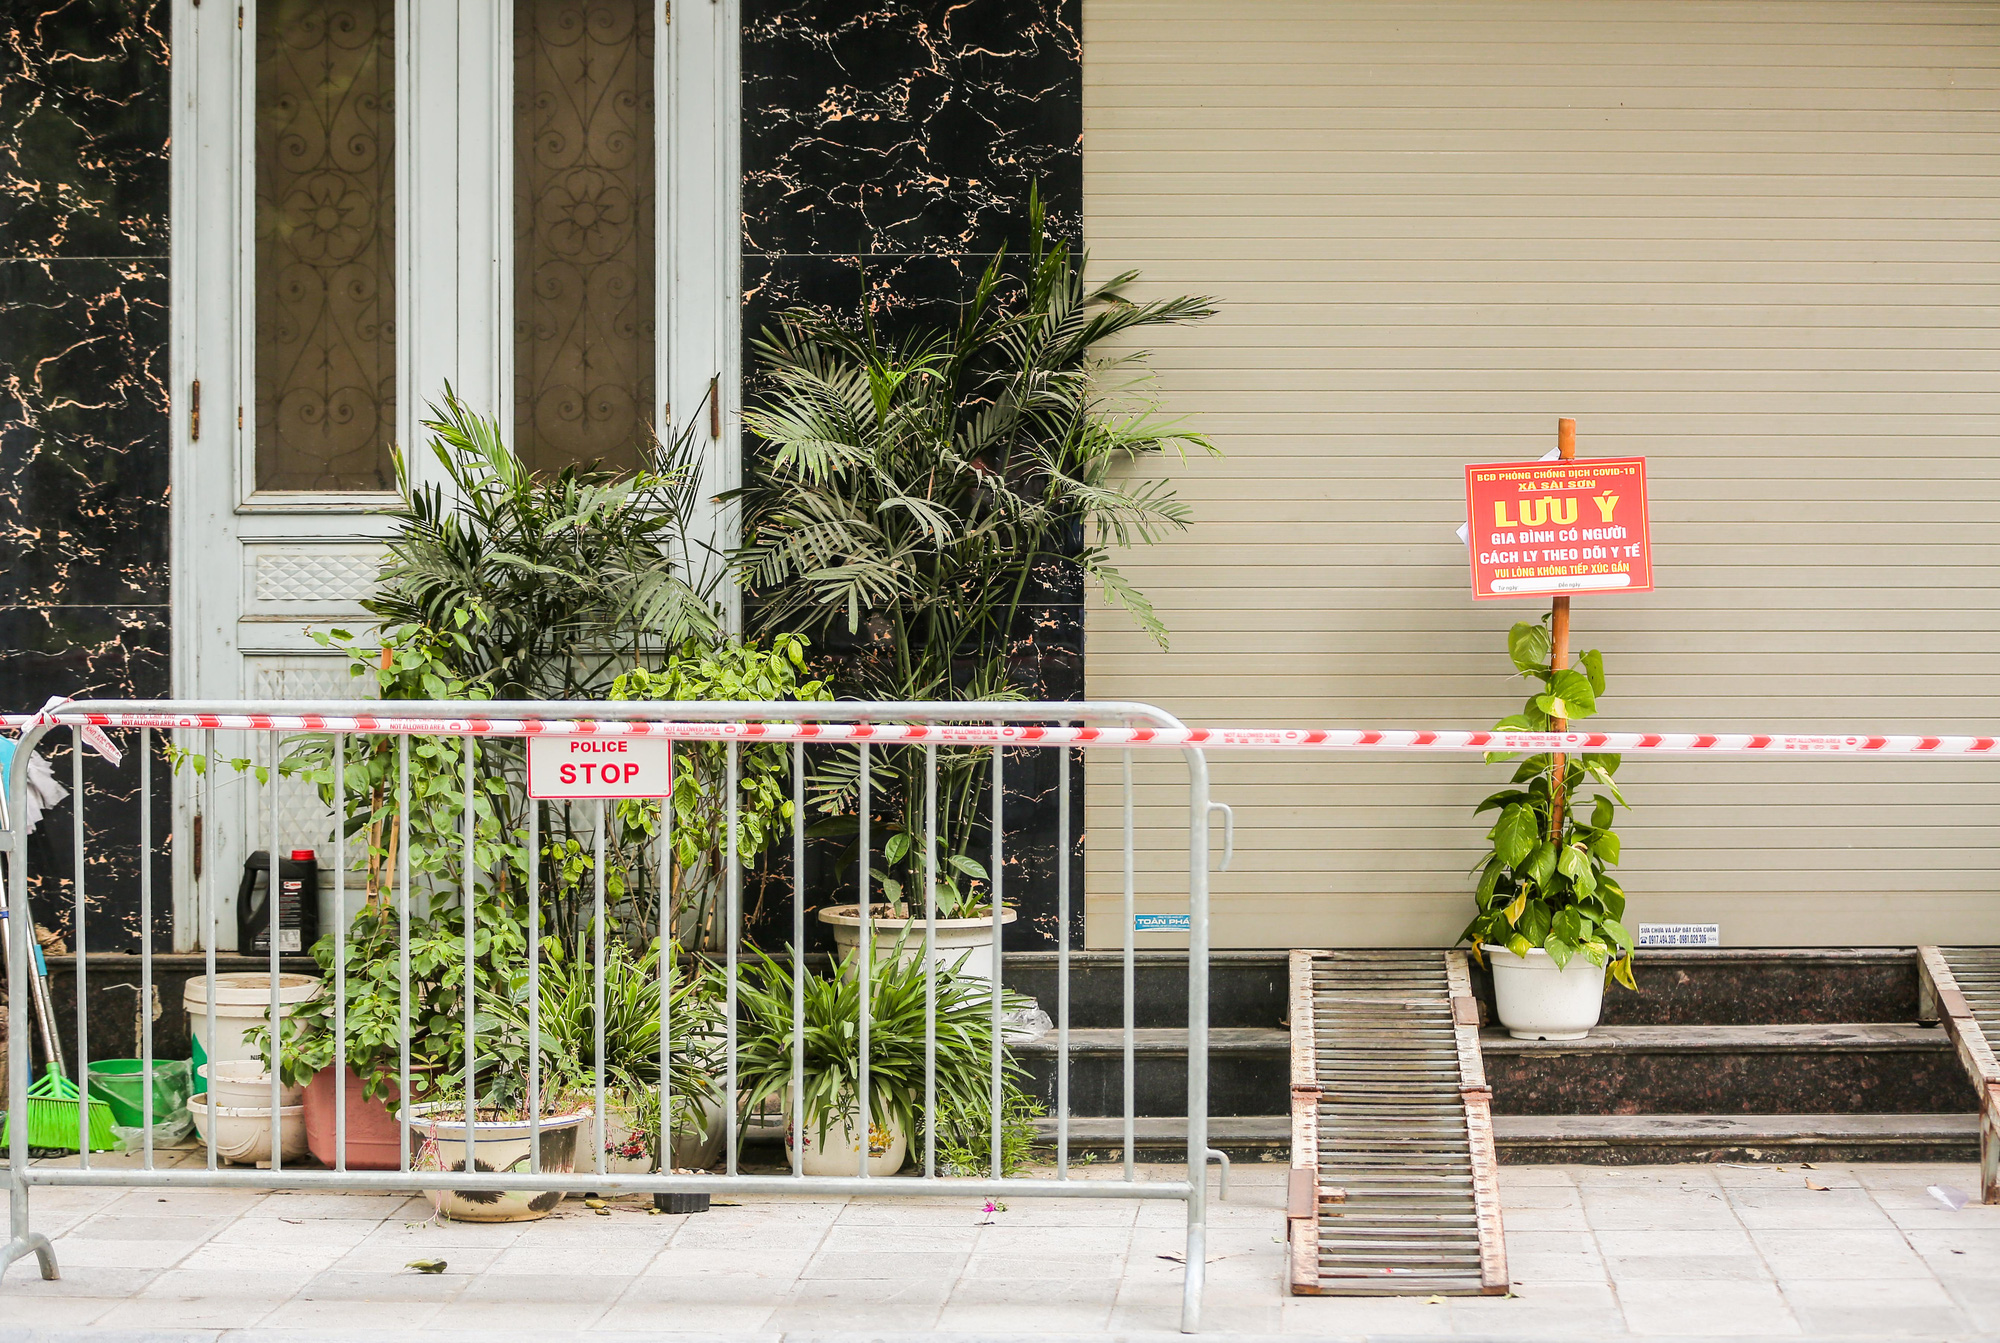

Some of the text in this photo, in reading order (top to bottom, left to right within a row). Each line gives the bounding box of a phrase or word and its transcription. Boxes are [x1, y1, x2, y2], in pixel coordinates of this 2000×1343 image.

[1477, 467, 1636, 482] BCĐ PHÒNG CHỐNG DỊCH COVID-19
[1518, 479, 1596, 490] XÃ SÀI SƠN
[1494, 490, 1620, 528] LƯU Ý
[1491, 524, 1627, 545] GIA ĐÌNH CÓ NGƯỜI
[1480, 542, 1641, 564] CÁCH LY THEO DÕI Y TẾ
[1494, 560, 1630, 578] VUI LÒNG KHÔNG TIẾP XÚC GẦN
[402, 723, 429, 731] ALLOWED
[570, 741, 628, 753] POLICE
[559, 763, 640, 784] STOP
